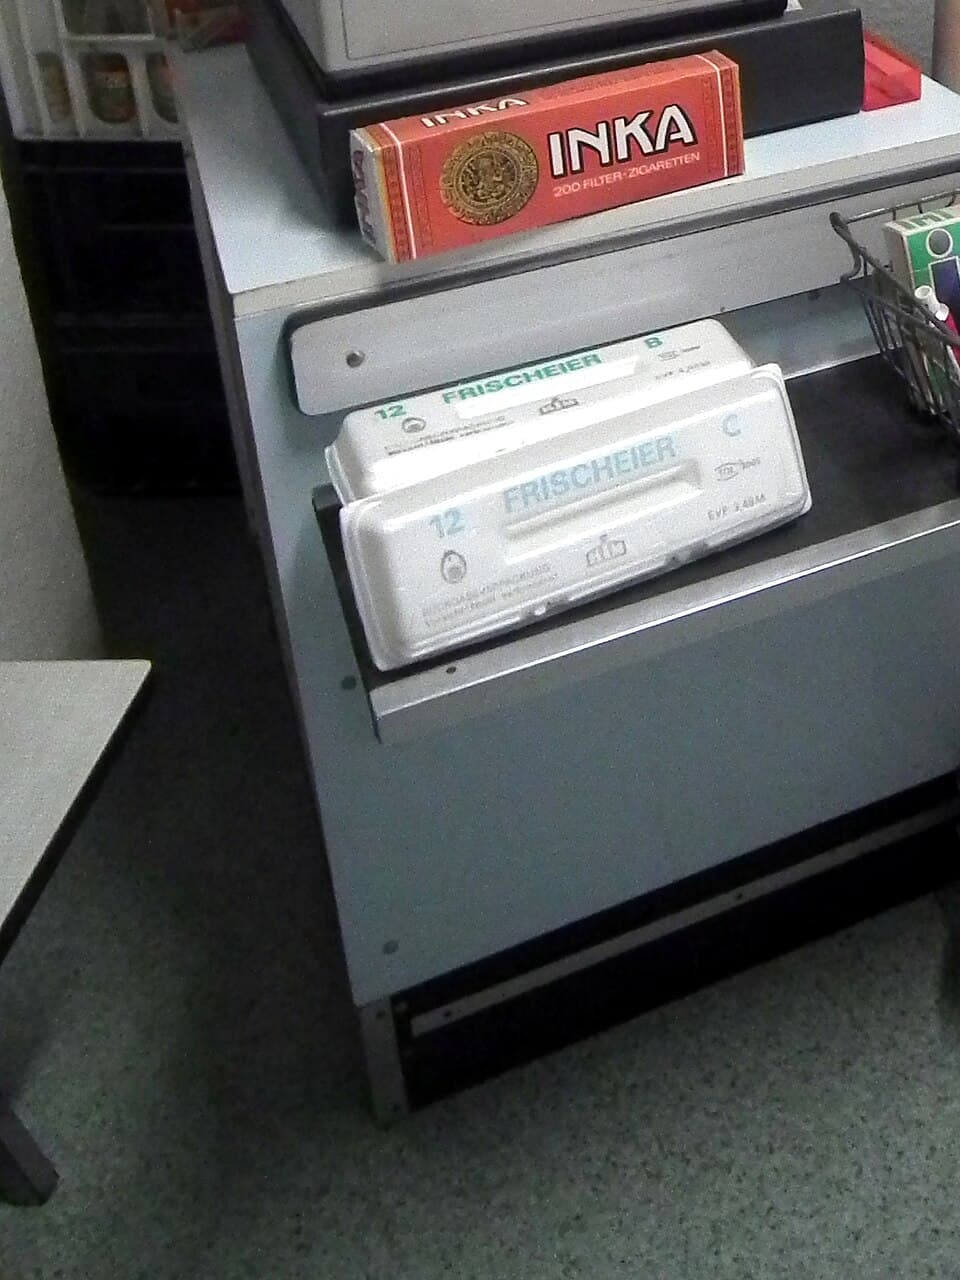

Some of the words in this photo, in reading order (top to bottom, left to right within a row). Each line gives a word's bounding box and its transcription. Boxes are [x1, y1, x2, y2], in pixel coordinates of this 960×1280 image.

[420, 97, 530, 128] INKA
[548, 104, 699, 178] INKA
[552, 181, 582, 198] 200
[375, 404, 407, 420] 12
[442, 352, 603, 405] FRISCHEIER
[643, 337, 664, 349] B
[430, 506, 467, 539] 12
[503, 432, 676, 515] FRISCHEIER
[722, 413, 742, 437] C
